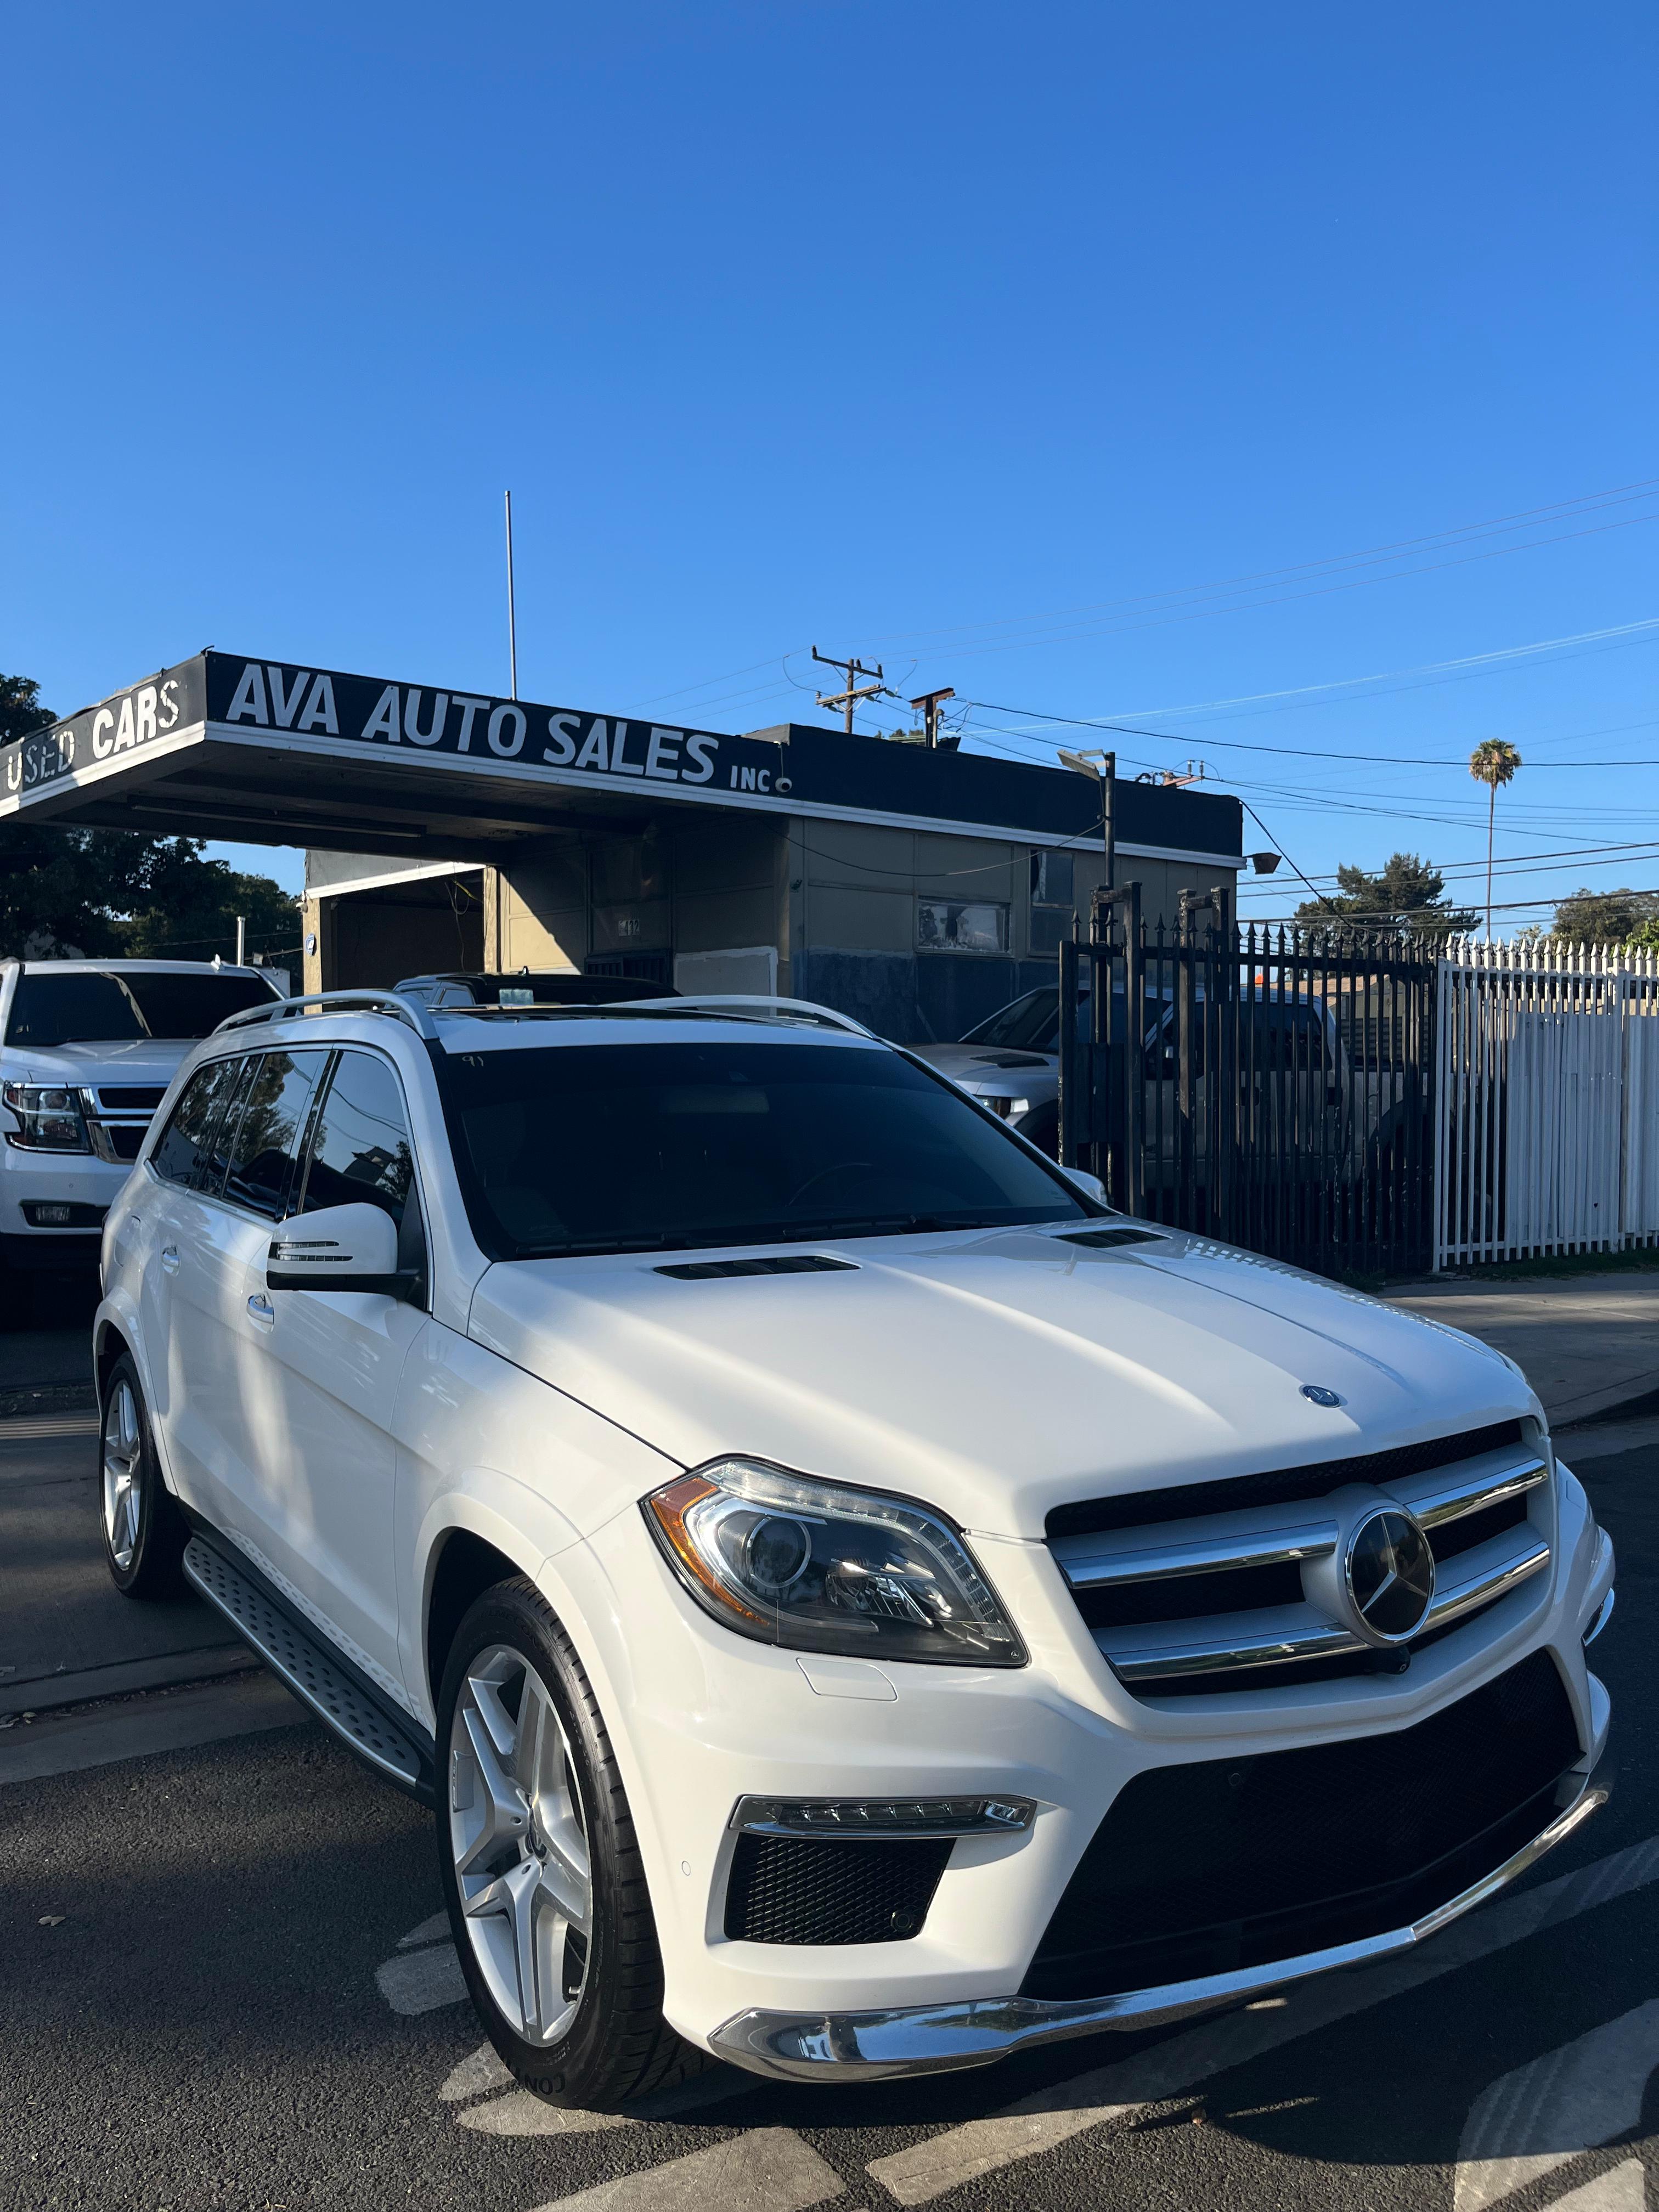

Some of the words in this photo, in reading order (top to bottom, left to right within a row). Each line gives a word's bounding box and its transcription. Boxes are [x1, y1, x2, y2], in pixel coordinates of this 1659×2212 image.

[8, 731, 74, 790] USED
[92, 680, 179, 759] CARS
[227, 663, 339, 734] AVA
[360, 685, 527, 757] AUTO
[543, 714, 719, 783] SALES
[730, 766, 770, 792] INC
[461, 1055, 484, 1067] 91
